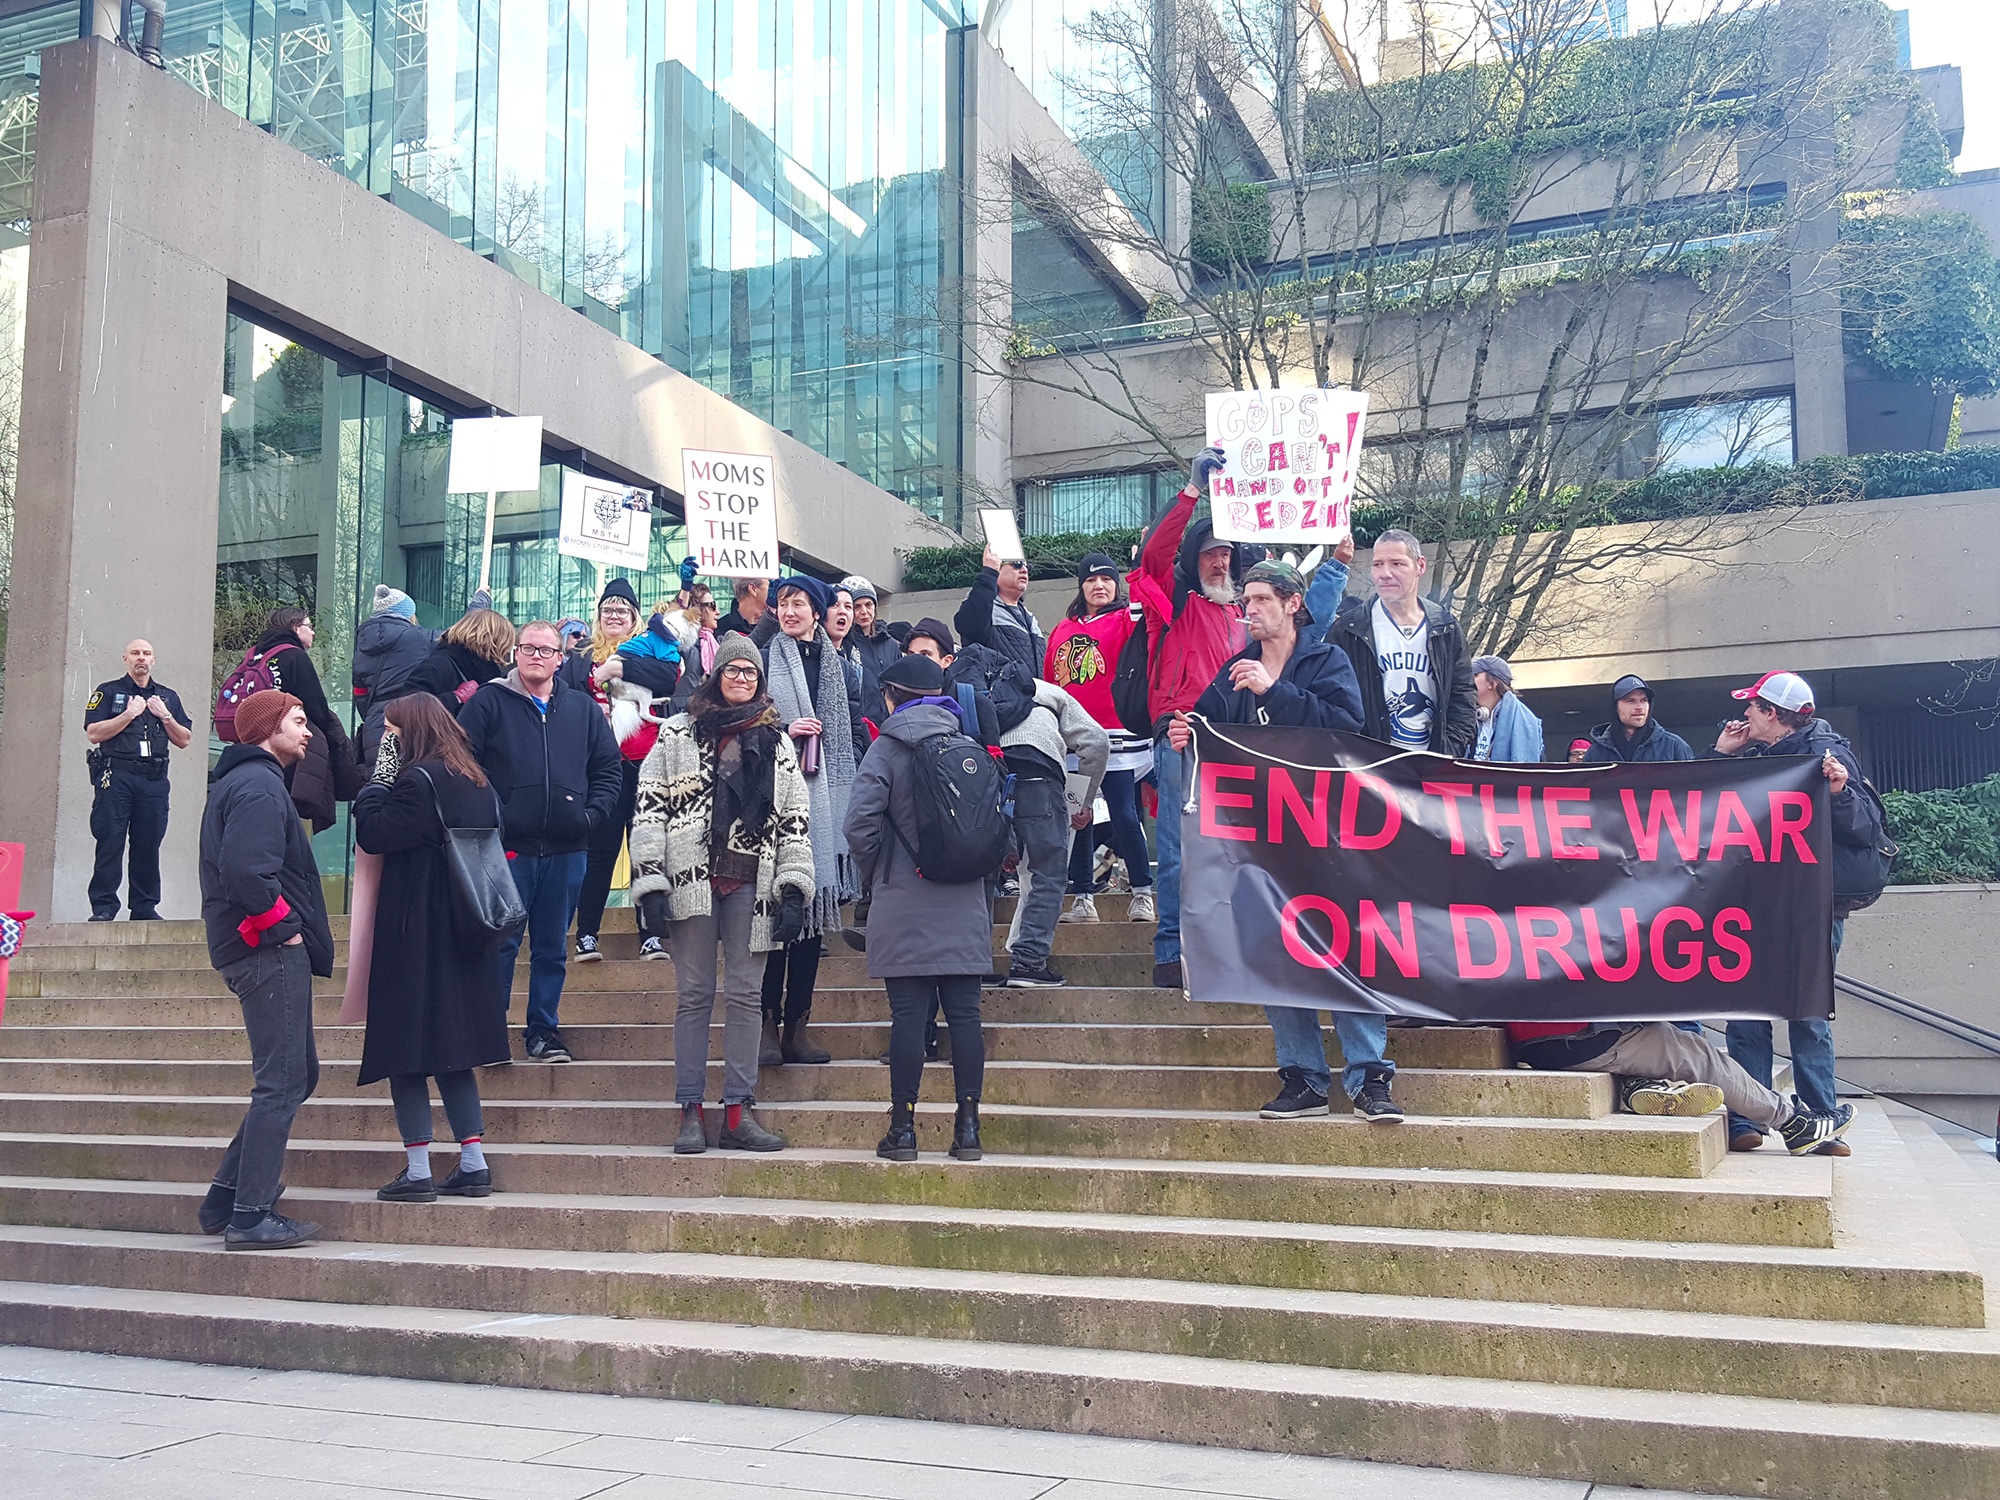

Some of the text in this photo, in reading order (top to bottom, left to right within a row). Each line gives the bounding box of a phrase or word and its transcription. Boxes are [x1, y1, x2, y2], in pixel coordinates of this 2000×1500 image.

[1217, 394, 1319, 441] COPS
[1241, 433, 1341, 476] CAN'T
[691, 460, 765, 487] MOMS
[1213, 476, 1332, 499] HAND OUT
[697, 490, 759, 515] STOP
[704, 519, 751, 542] THE
[570, 538, 591, 548] MOMS
[592, 543, 610, 551] STOP
[625, 550, 645, 558] HARM
[701, 547, 769, 570] HARM
[1380, 652, 1431, 675] NCOU
[1200, 762, 1818, 864] END THE WAR
[1280, 894, 1752, 982] ON DRUGS
